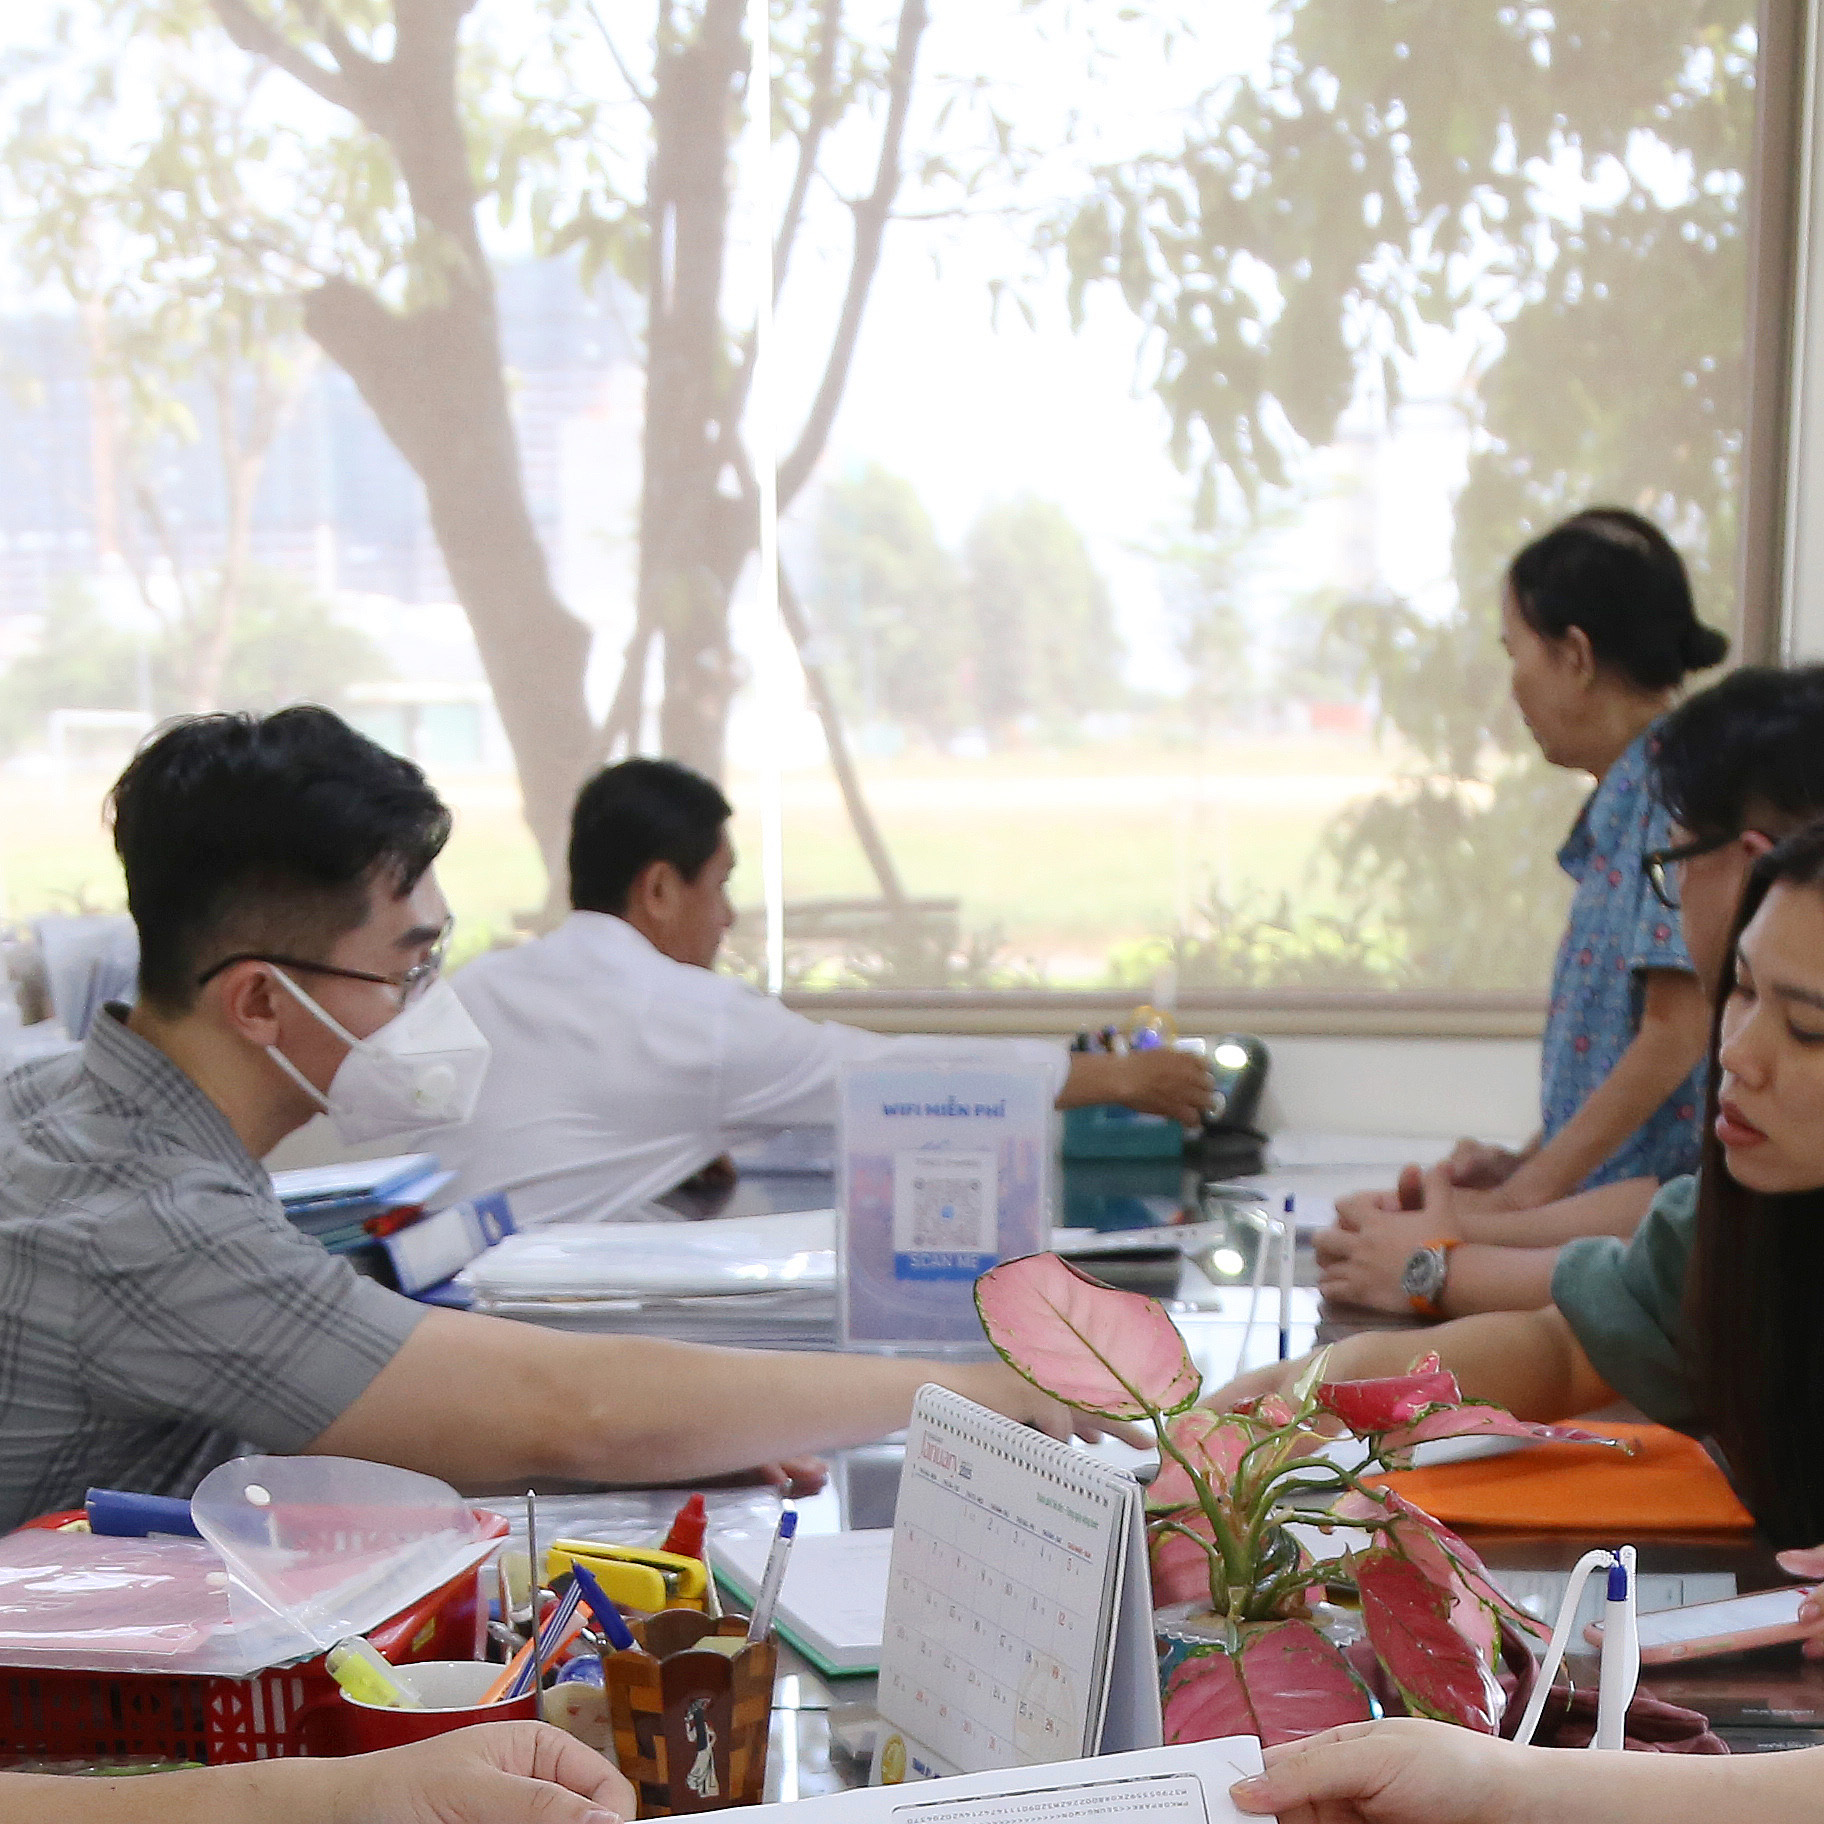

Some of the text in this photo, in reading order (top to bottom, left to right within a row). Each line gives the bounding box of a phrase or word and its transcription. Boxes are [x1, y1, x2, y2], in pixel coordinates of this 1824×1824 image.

[883, 1094, 1006, 1117] WIFI MIỄN PHÍ
[910, 1253, 979, 1268] SCAN ME
[918, 1429, 957, 1478] January
